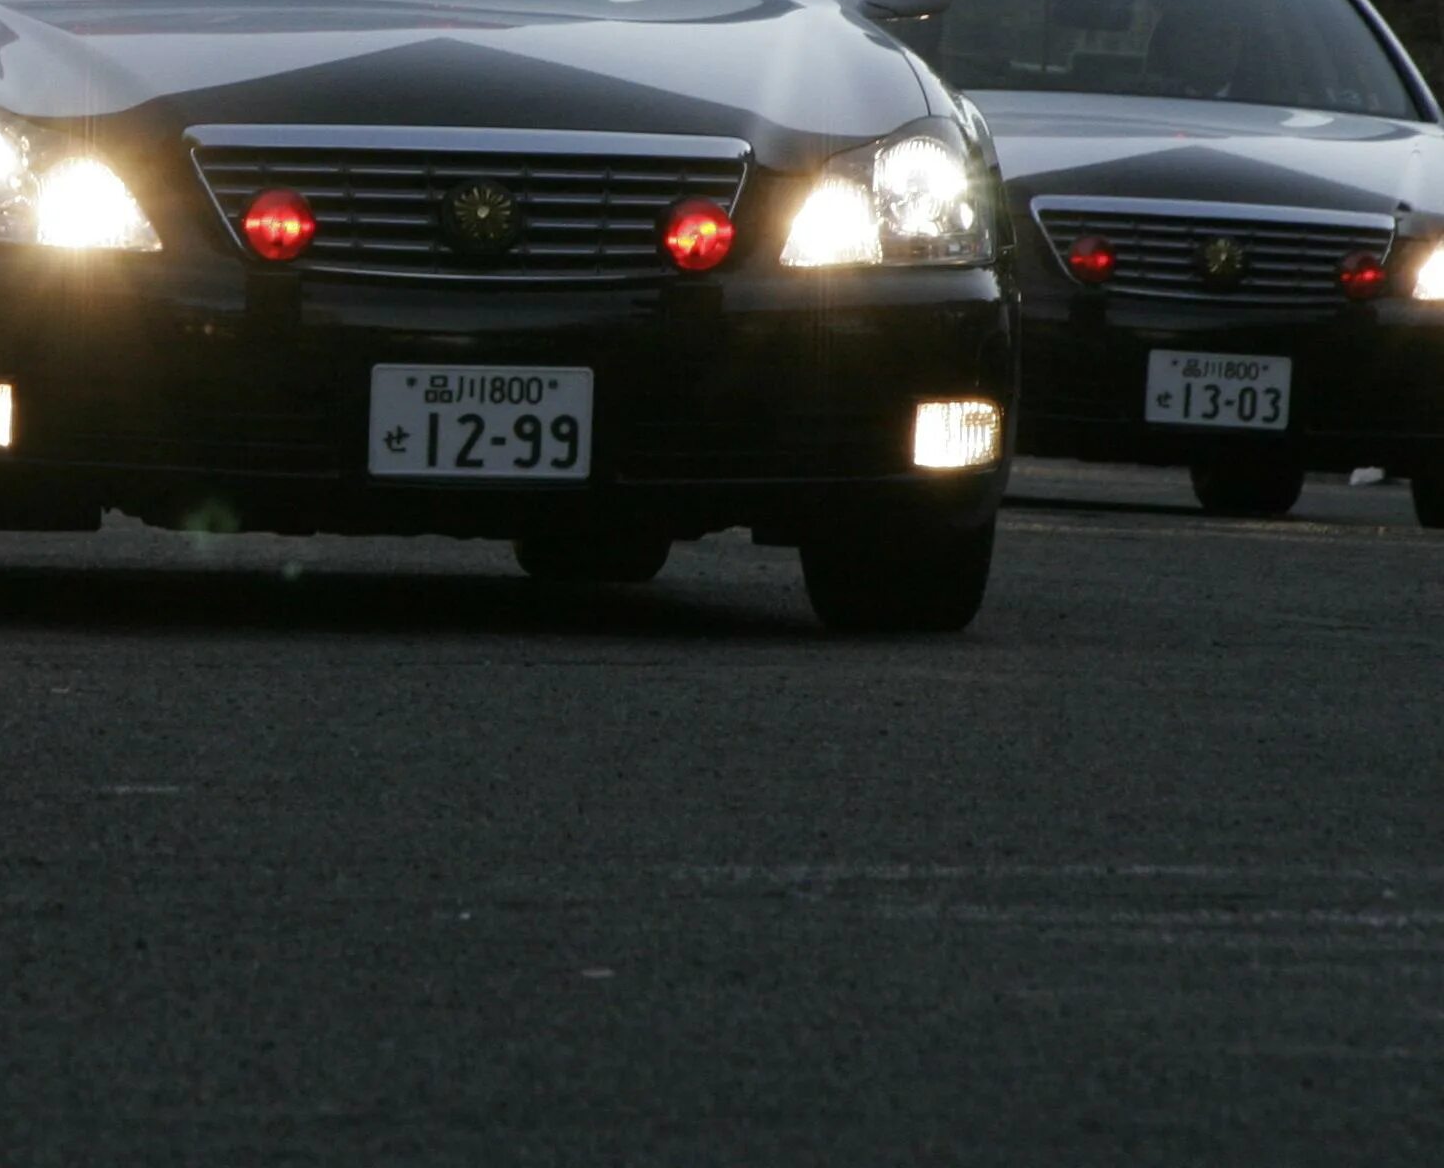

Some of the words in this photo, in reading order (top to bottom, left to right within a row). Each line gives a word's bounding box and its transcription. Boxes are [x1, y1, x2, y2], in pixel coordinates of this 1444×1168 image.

[1183, 383, 1282, 423] 13-03
[383, 425, 410, 454] せ
[426, 412, 579, 469] 12-99
